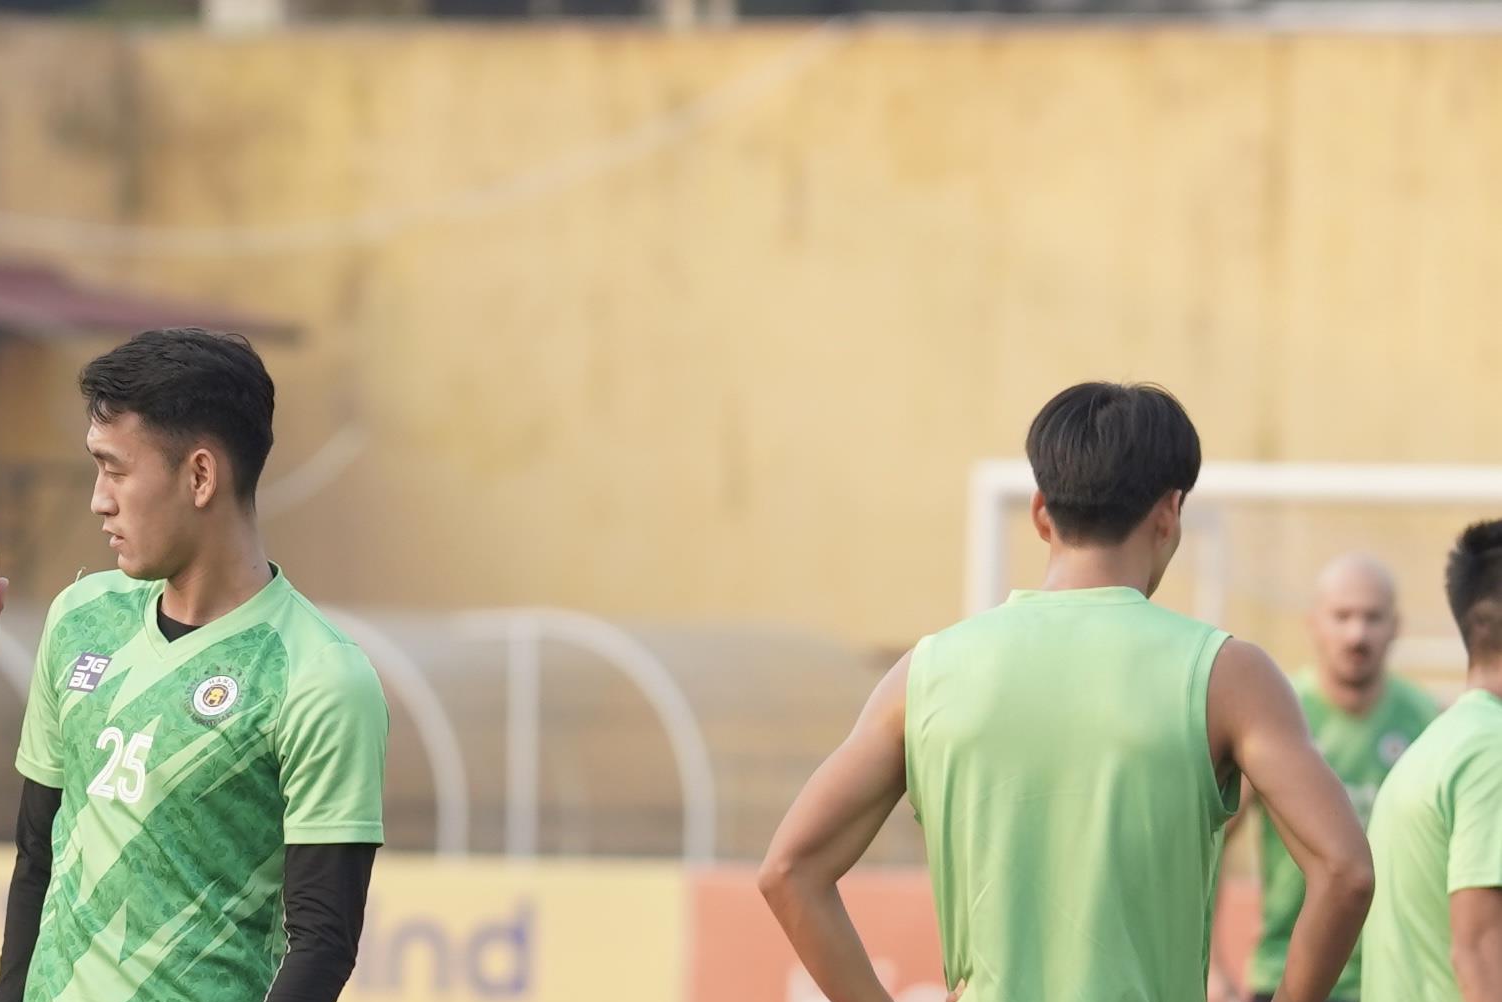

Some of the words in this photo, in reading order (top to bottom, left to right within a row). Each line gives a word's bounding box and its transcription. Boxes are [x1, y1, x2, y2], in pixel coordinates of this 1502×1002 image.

[76, 655, 108, 674] JG
[69, 671, 95, 690] BL
[86, 726, 154, 804] 25
